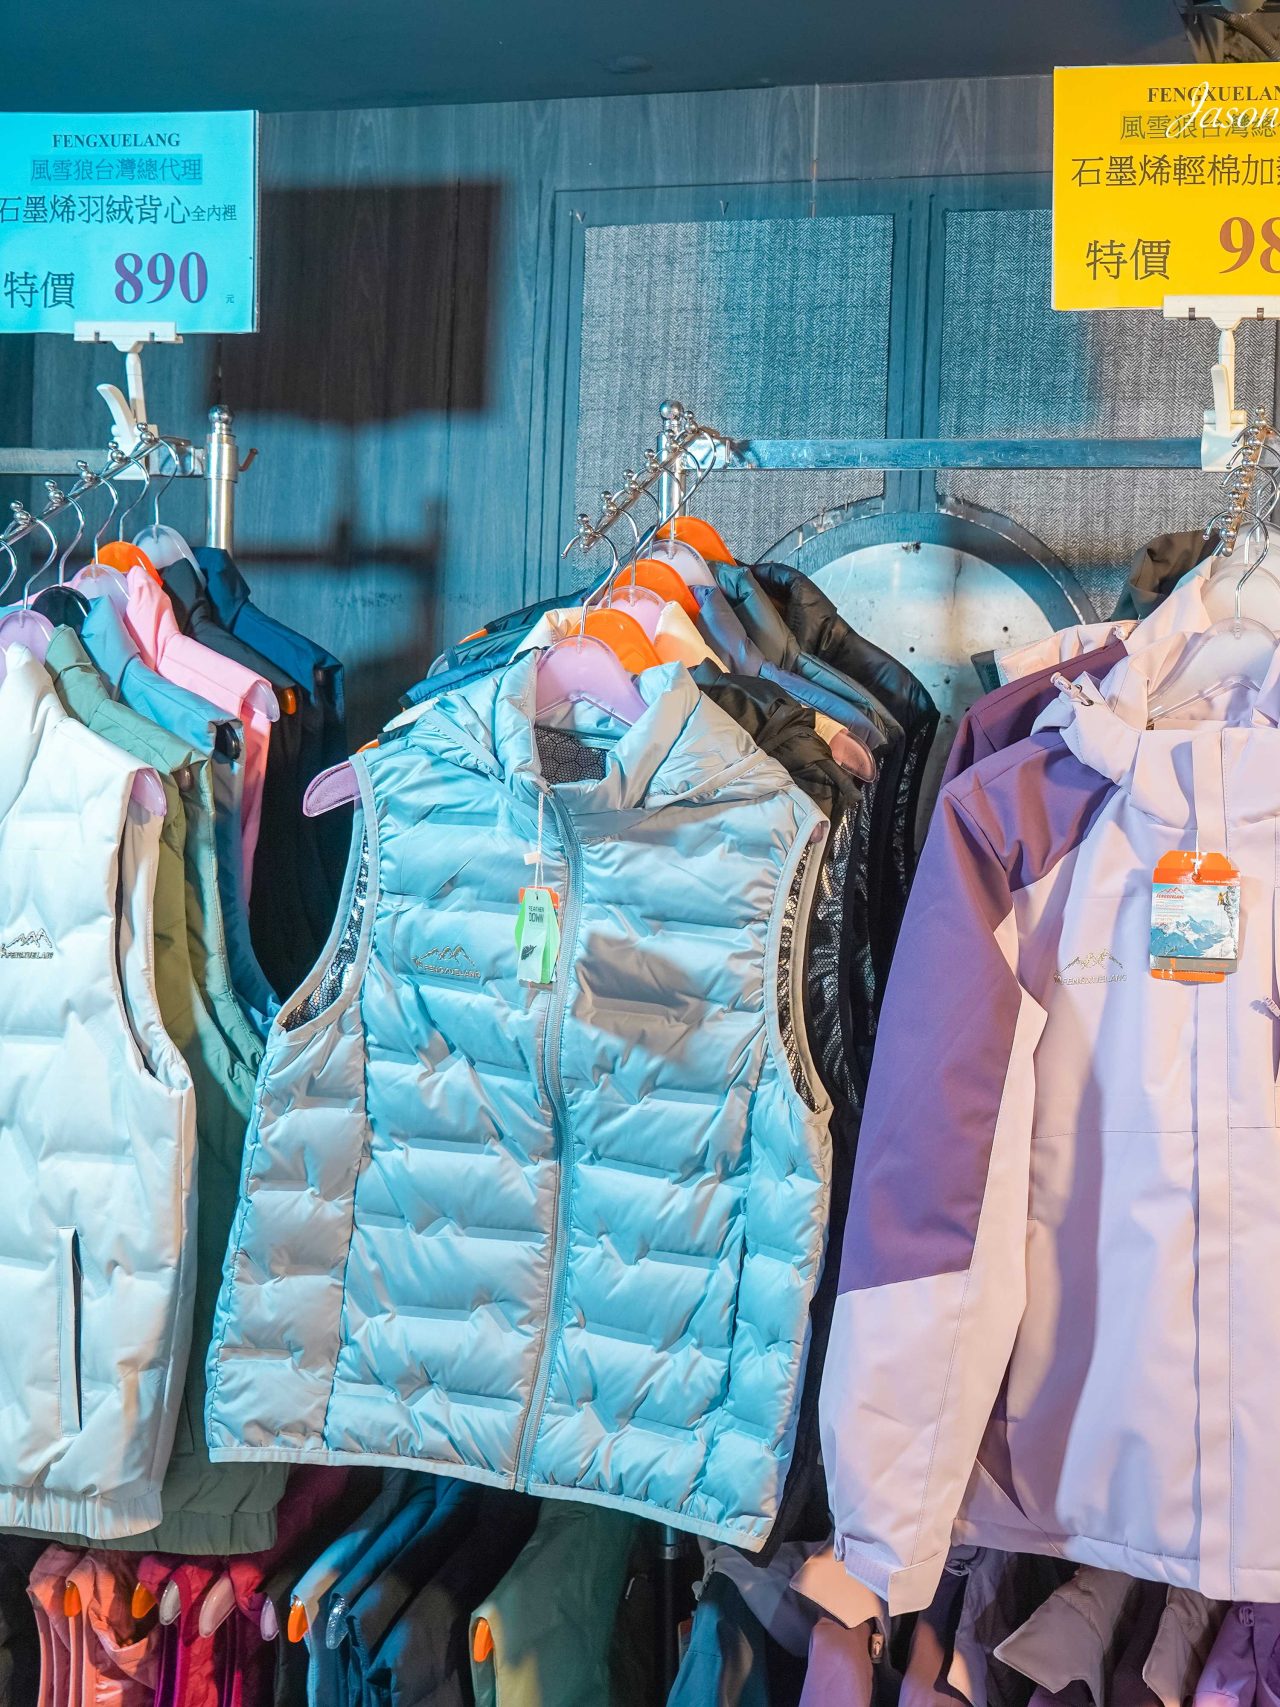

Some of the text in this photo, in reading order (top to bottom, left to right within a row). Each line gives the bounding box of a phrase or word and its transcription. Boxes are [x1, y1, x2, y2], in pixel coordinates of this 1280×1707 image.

[53, 133, 180, 148] FENGXUELANG
[31, 159, 202, 182] 風雪狼台灣總代理
[1086, 238, 1172, 281] 特價
[3, 271, 75, 309] 特價
[114, 252, 208, 304] 890
[528, 912, 544, 922] DOWN
